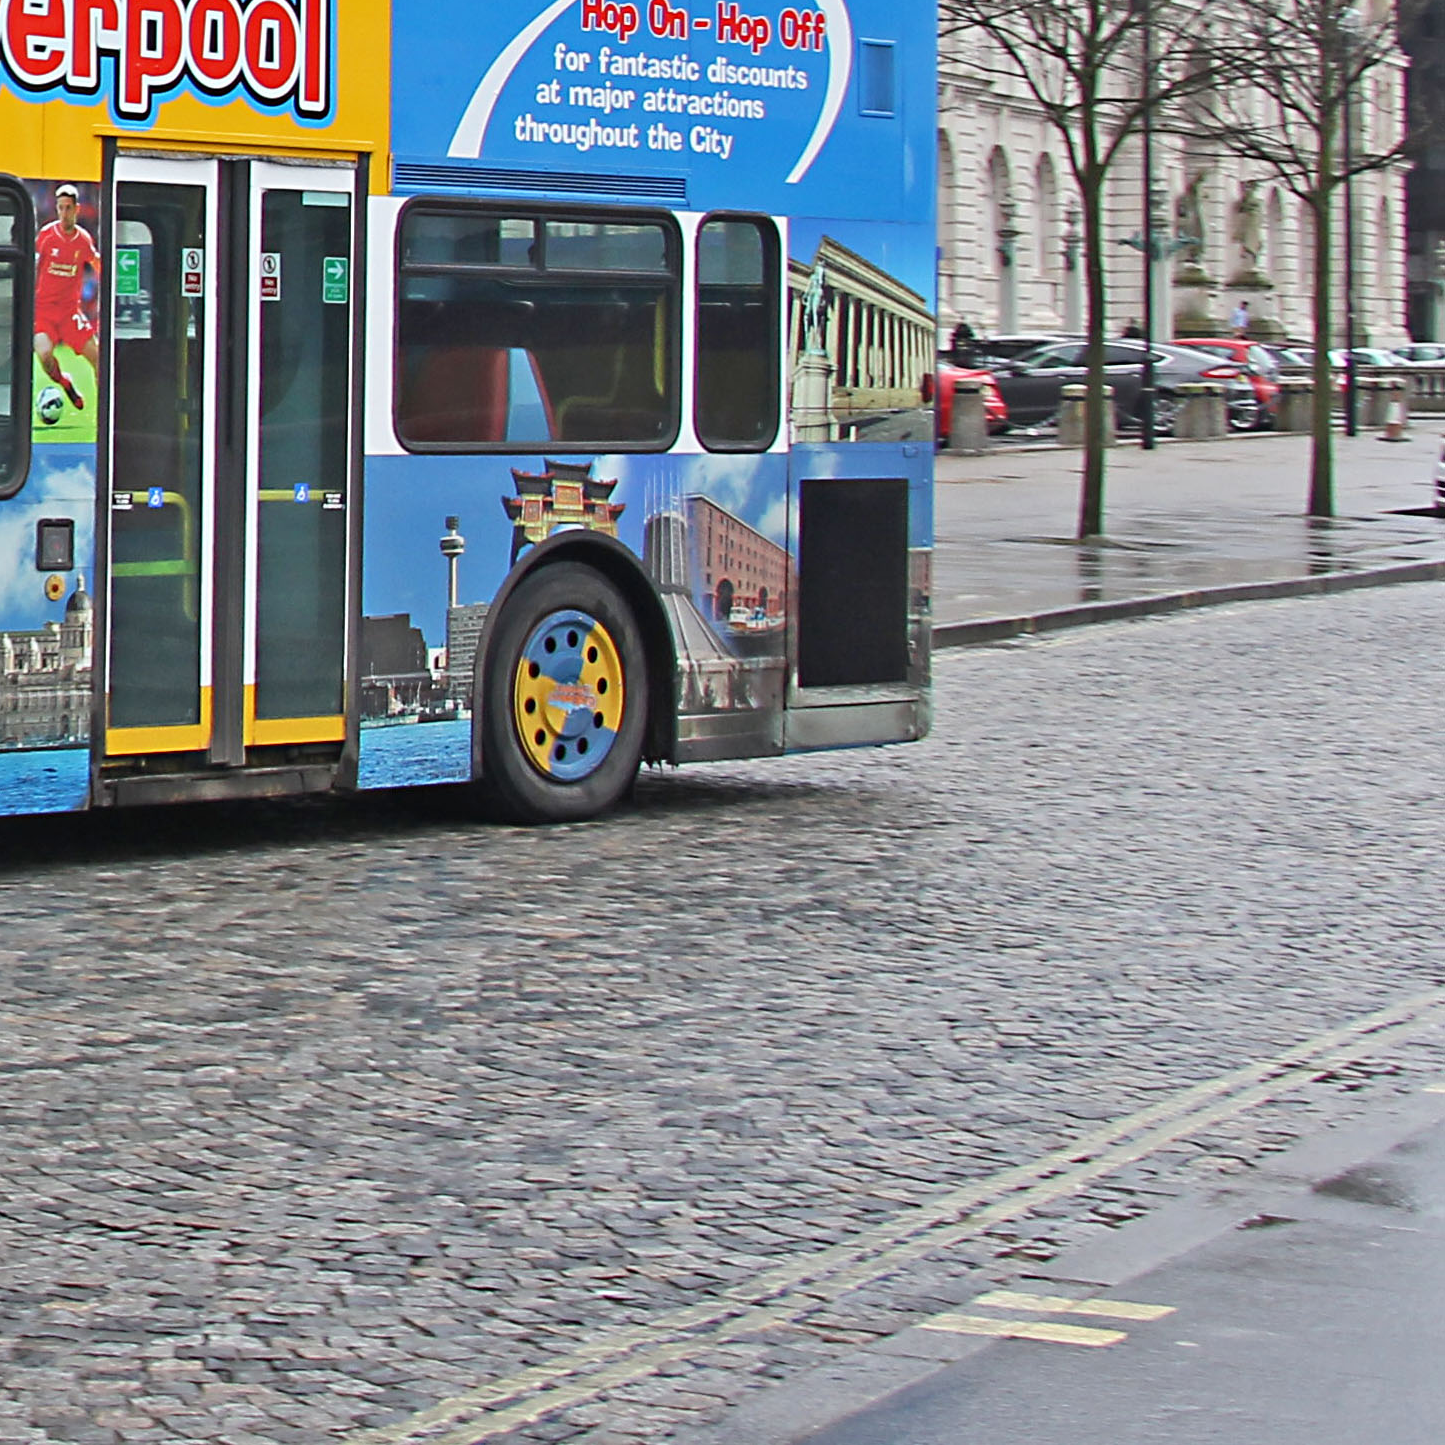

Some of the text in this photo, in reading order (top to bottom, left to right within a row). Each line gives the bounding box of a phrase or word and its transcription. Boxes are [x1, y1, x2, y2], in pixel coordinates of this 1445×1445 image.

[716, 0, 769, 53] Hop
[780, 8, 826, 52] Off
[554, 43, 808, 90] for fantastic discounts
[536, 82, 765, 120] at major attractions
[514, 115, 733, 159] throughout the City
